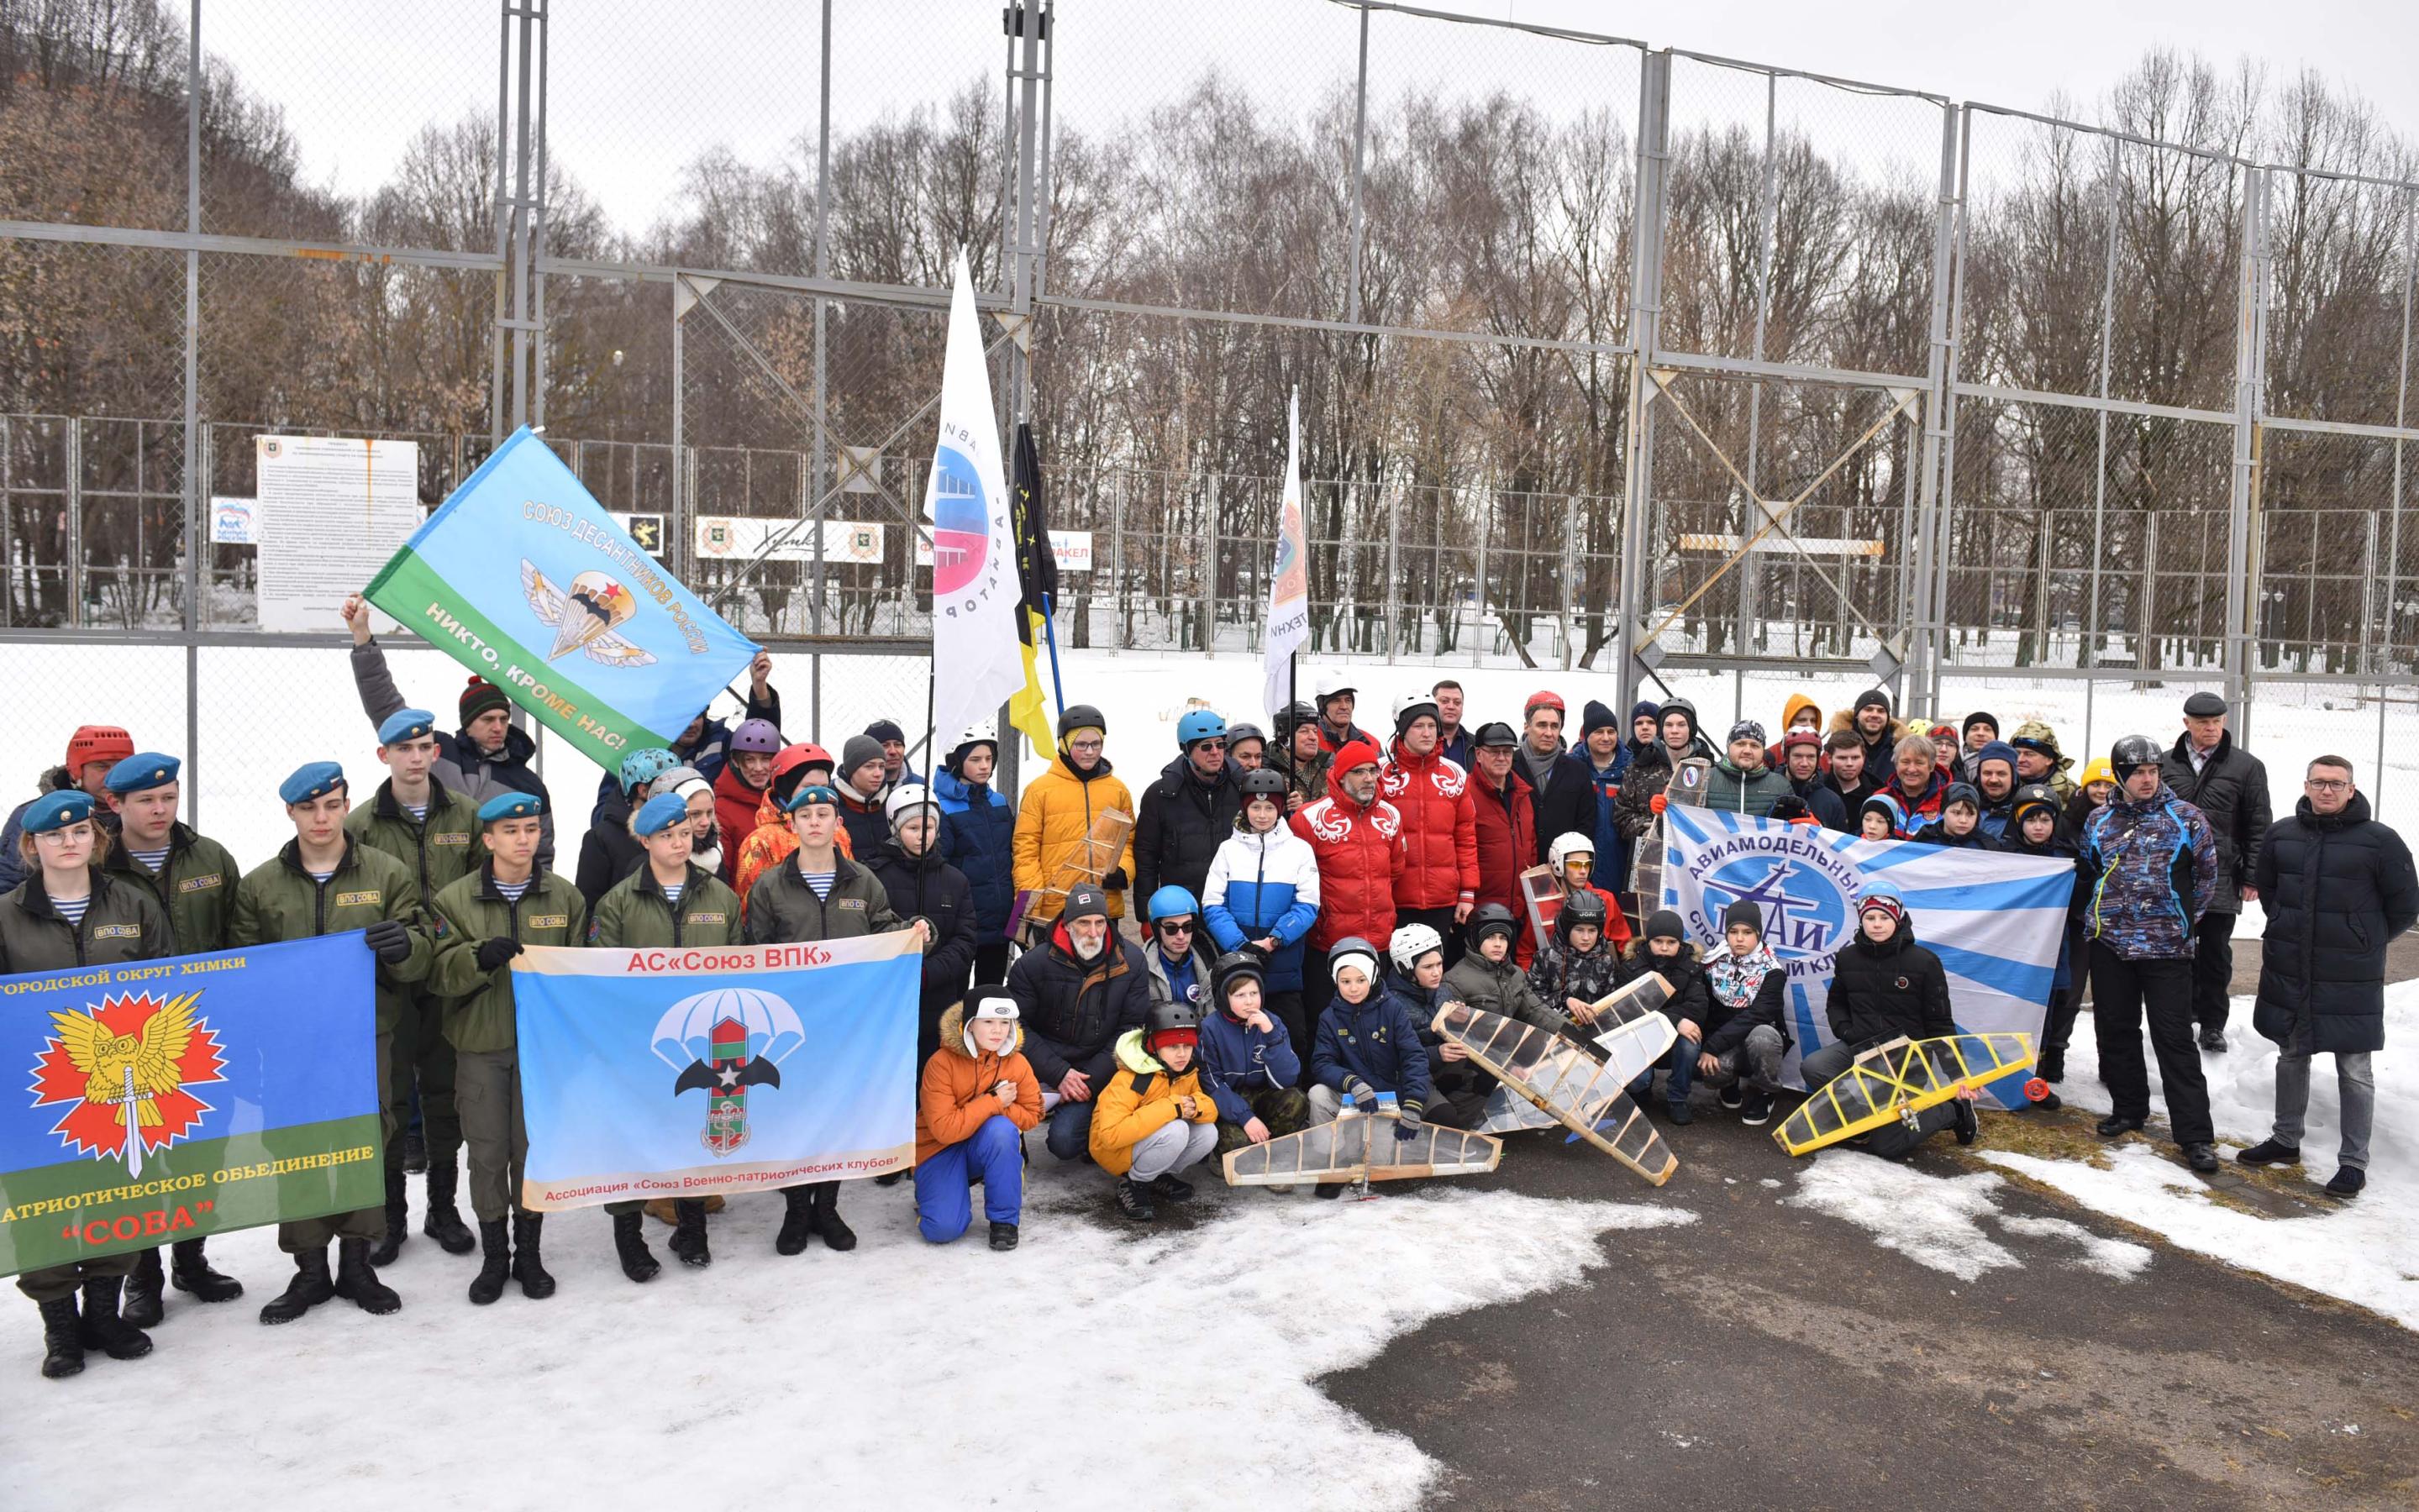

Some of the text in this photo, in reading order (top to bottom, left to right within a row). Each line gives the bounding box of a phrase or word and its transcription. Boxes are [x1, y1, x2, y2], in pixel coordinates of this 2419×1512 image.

[523, 501, 709, 654] СОЮЗ ДЕСАНТНИКОВ РОССИИ
[425, 601, 628, 750] НИКТО, КРОМЕ НАС!
[450, 834, 467, 843] СОВА
[181, 877, 219, 890] ВПО СОВА
[339, 893, 378, 904] ВПО СОВА
[704, 914, 723, 922] СОВА
[1715, 892, 1828, 953] АИ
[97, 927, 116, 937] ВПО
[765, 946, 832, 968] ВПК»
[116, 965, 175, 983] ОКРУГ
[181, 957, 247, 975] ХИМКИ
[544, 1154, 900, 1202] Ассоциация «Союз Военно-патриотических клубов»
[61, 1200, 214, 1245] “СОВА”
